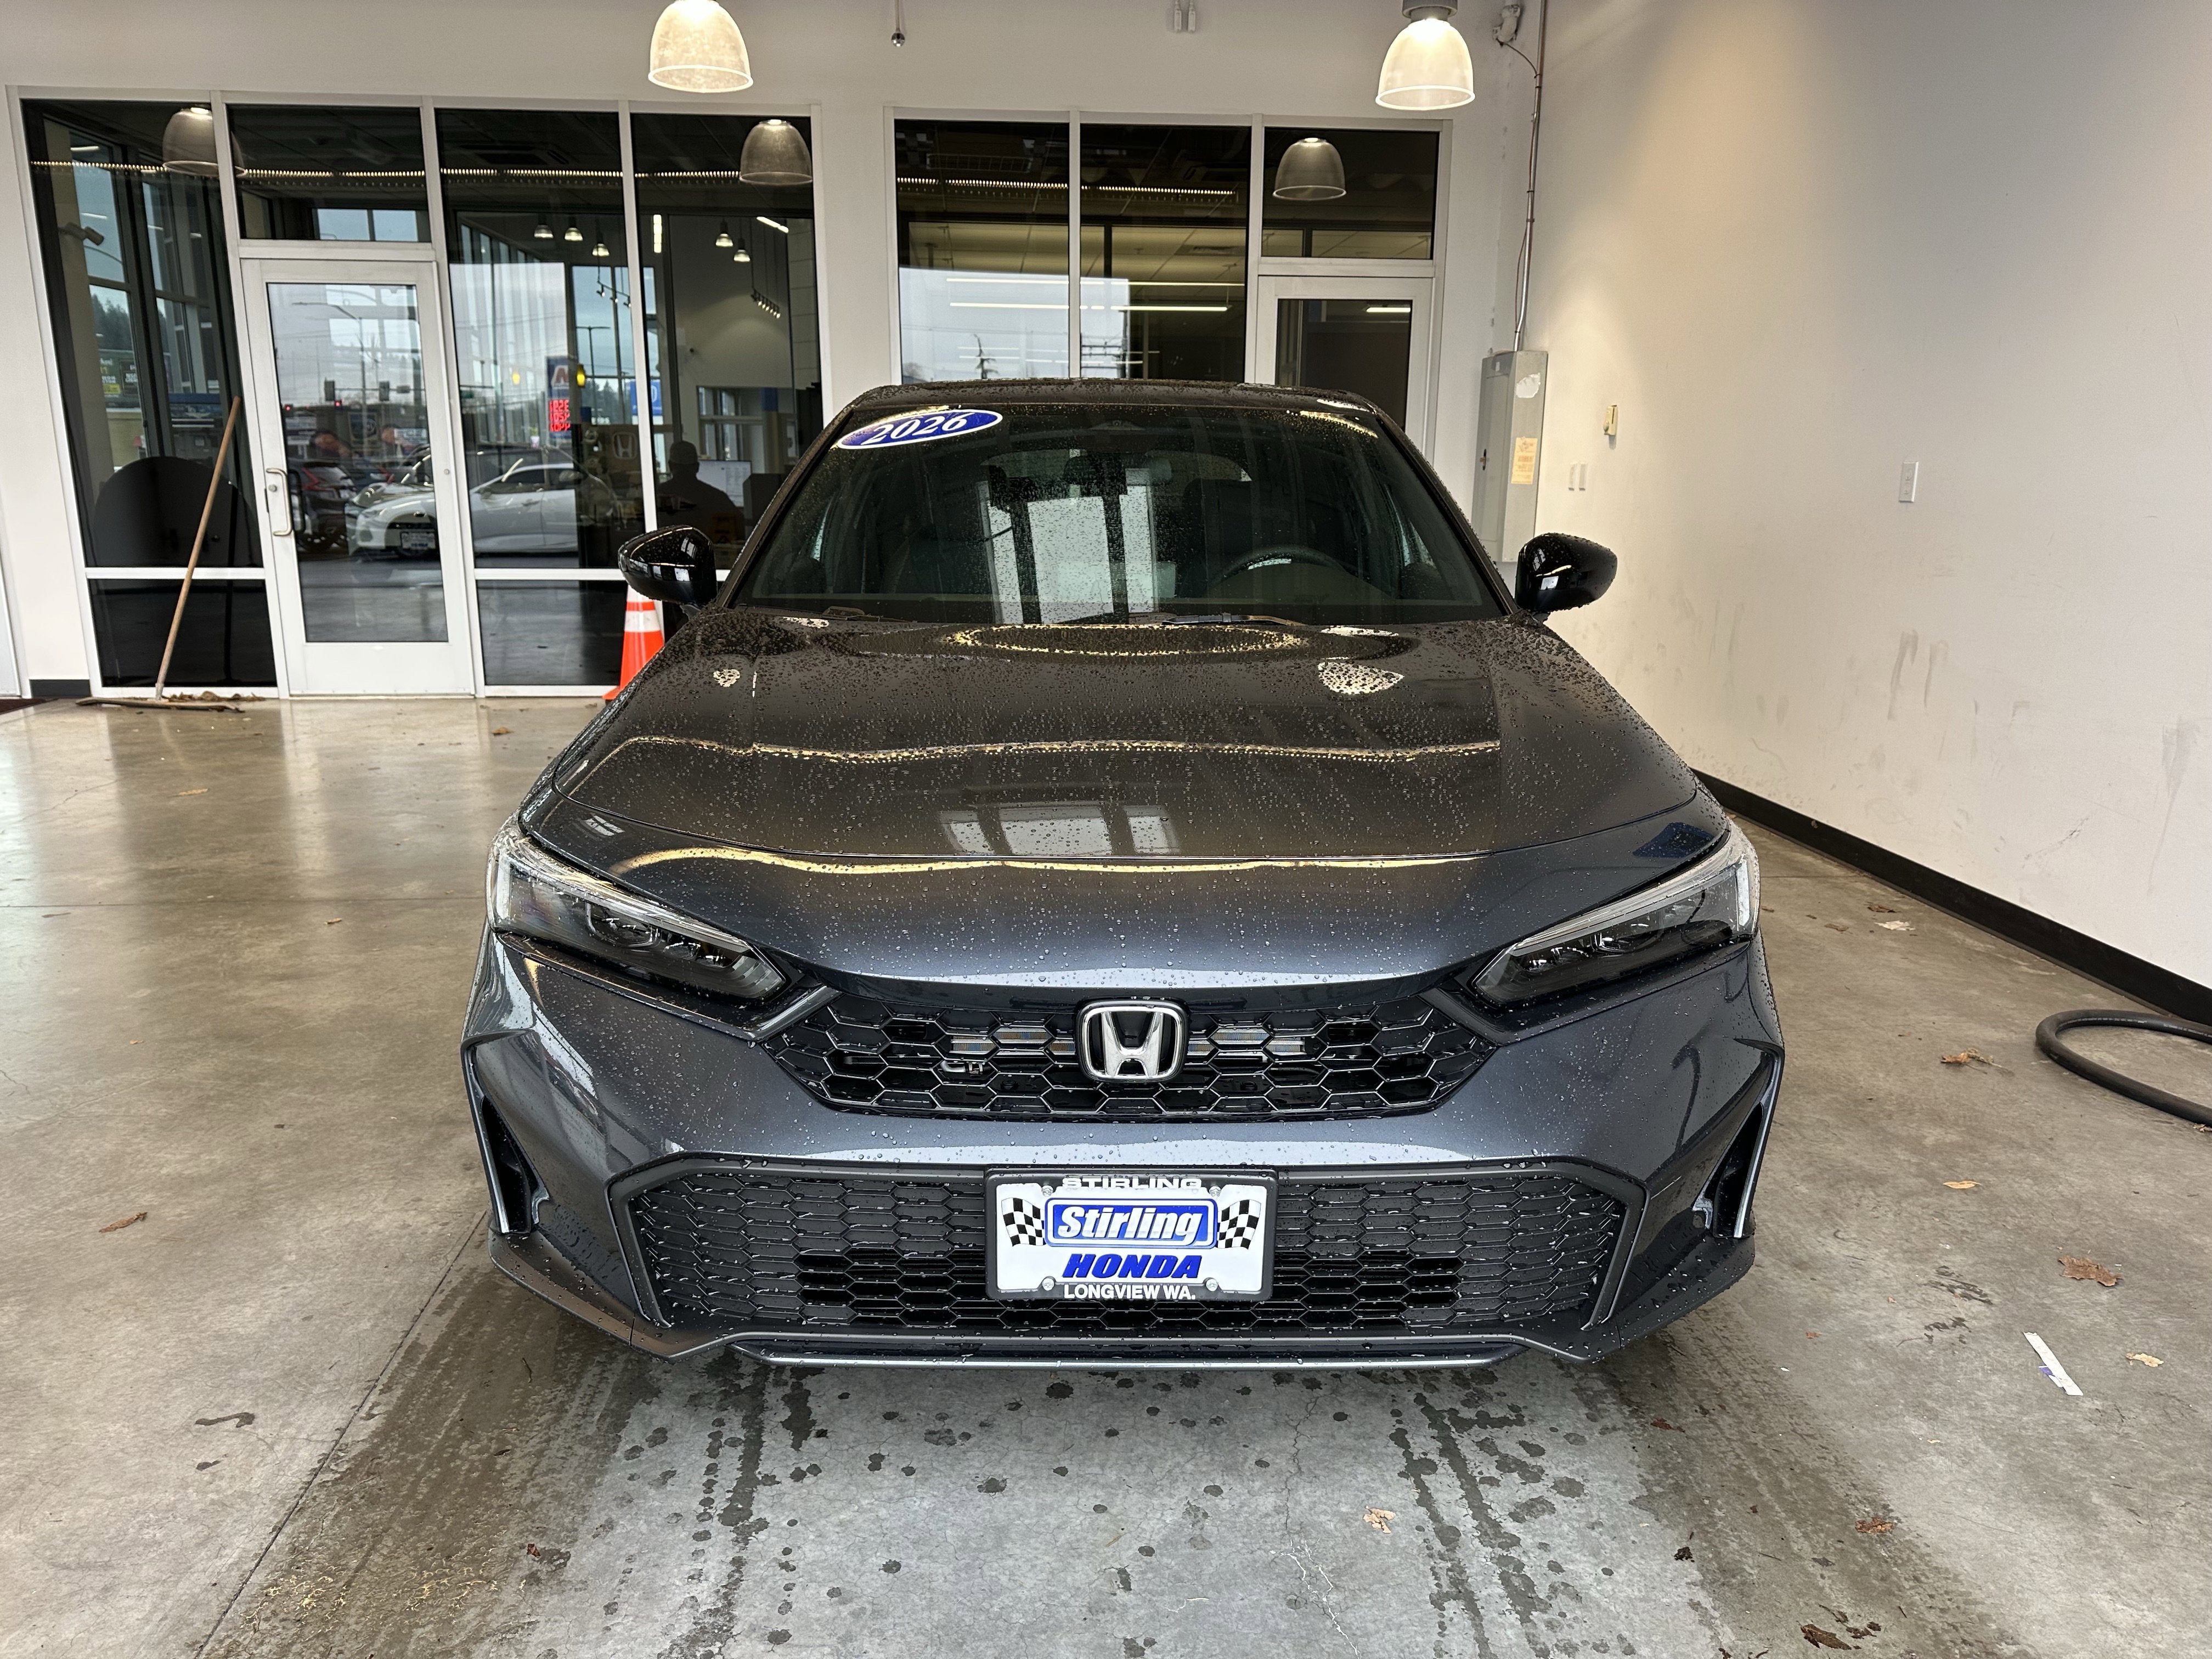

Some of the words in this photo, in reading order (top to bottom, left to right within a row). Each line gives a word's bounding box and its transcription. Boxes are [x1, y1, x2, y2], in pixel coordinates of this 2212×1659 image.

[861, 412, 975, 445] 2026
[1063, 1175, 1201, 1189] STIRLING
[1058, 1206, 1203, 1245] Stirling
[1062, 1254, 1203, 1278] HONDA
[1064, 1284, 1159, 1299] LONGVIEW
[1163, 1286, 1196, 1300] WA.
